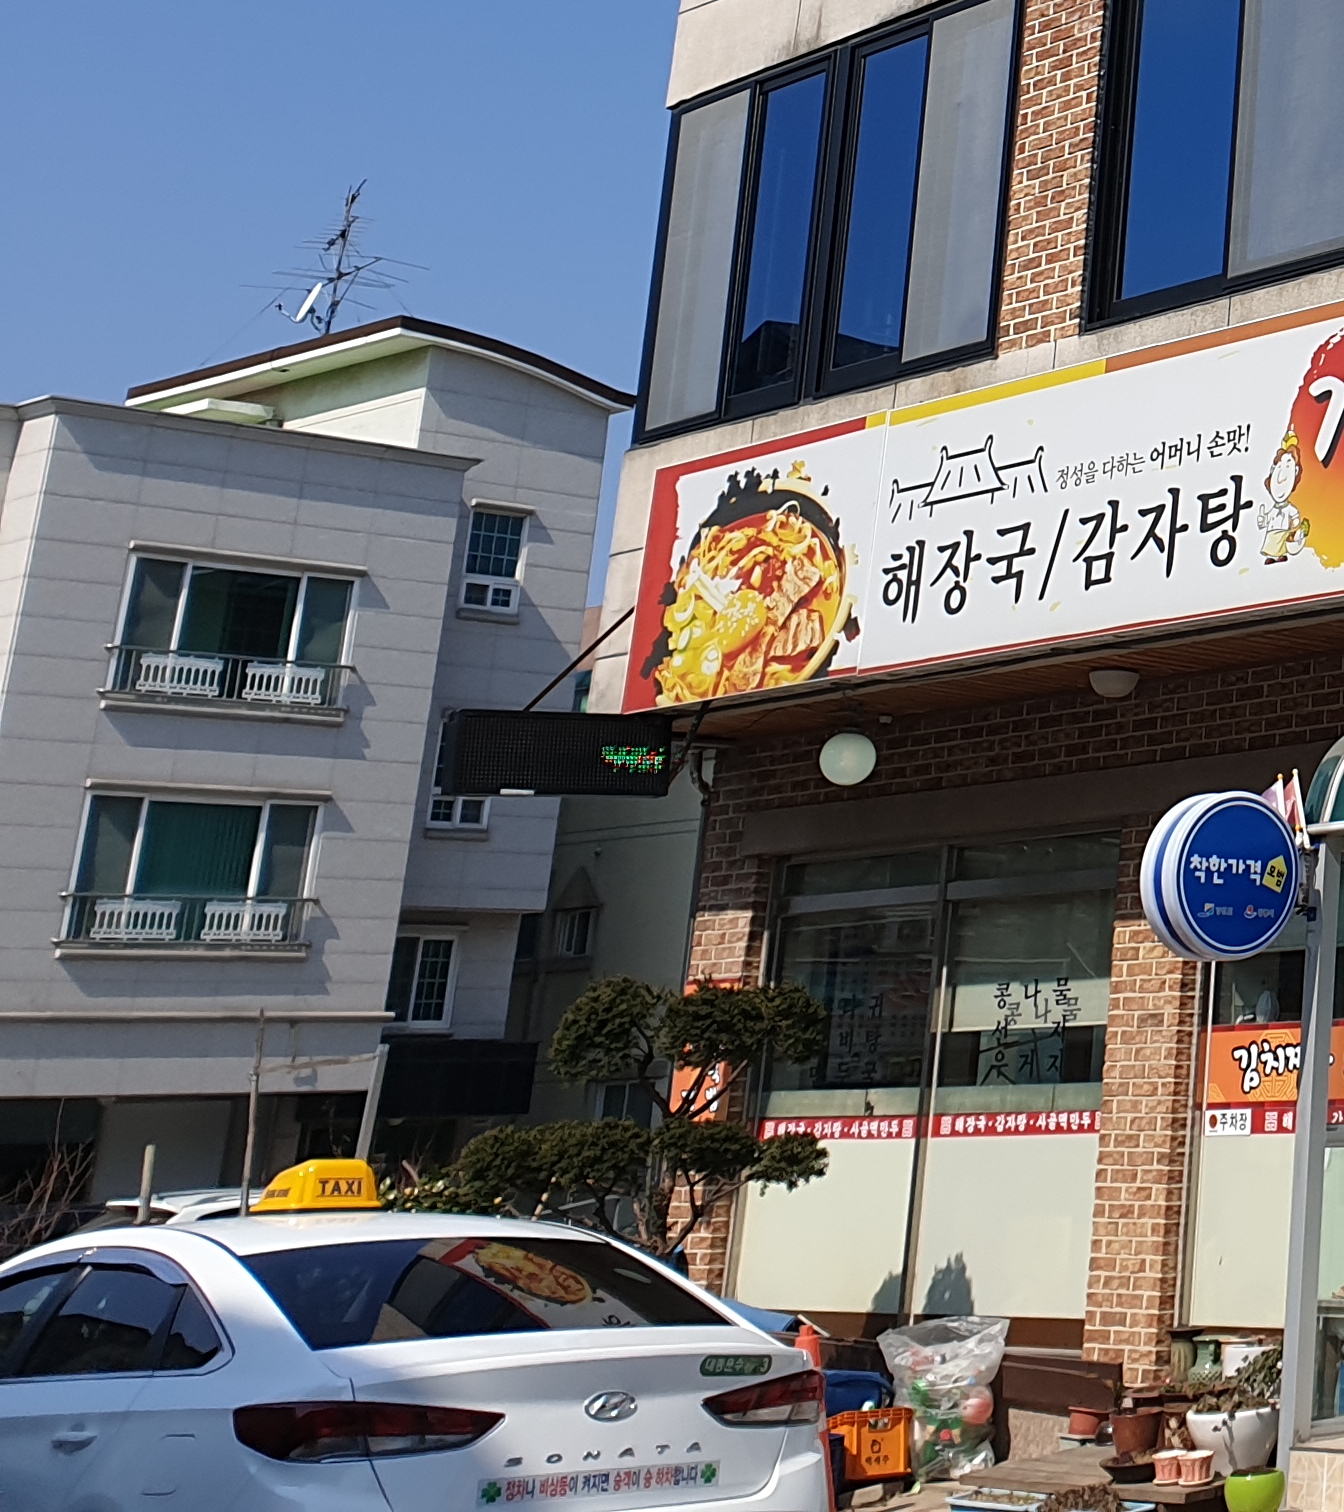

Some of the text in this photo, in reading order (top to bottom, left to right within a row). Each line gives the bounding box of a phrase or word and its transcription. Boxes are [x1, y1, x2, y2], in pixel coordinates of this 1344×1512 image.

[1056, 424, 1251, 490] 정성을 다하는 어머니 손맛!
[1189, 854, 1262, 886] 착한가격
[993, 977, 1071, 1009] 콩나물
[1219, 1112, 1248, 1132] 주차장
[318, 1180, 362, 1197] TAXI
[504, 1441, 703, 1468] SONATA
[538, 1474, 579, 1498] 비상등이
[613, 1467, 641, 1491] 승객이
